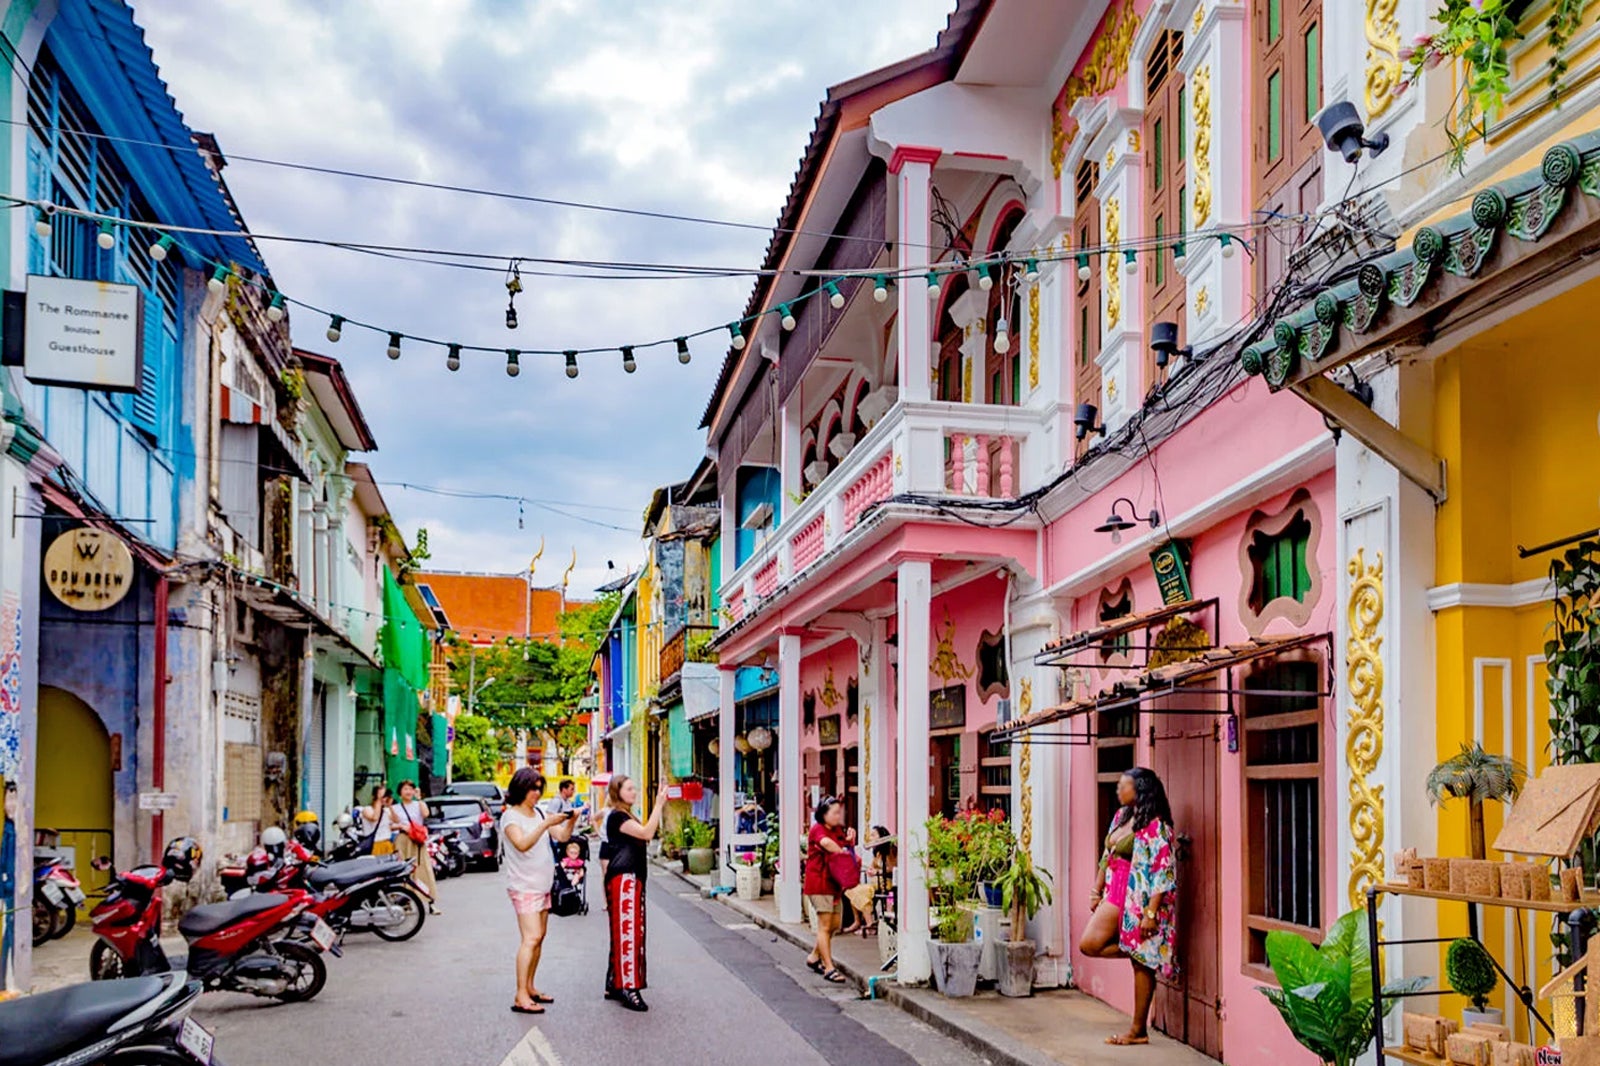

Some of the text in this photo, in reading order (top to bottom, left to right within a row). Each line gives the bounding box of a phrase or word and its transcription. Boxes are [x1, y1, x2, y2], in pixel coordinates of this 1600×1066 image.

[37, 302, 130, 320] The Rommanee
[63, 325, 101, 336] Boutique
[48, 341, 116, 356] Guesthouse
[1538, 1049, 1562, 1065] New
